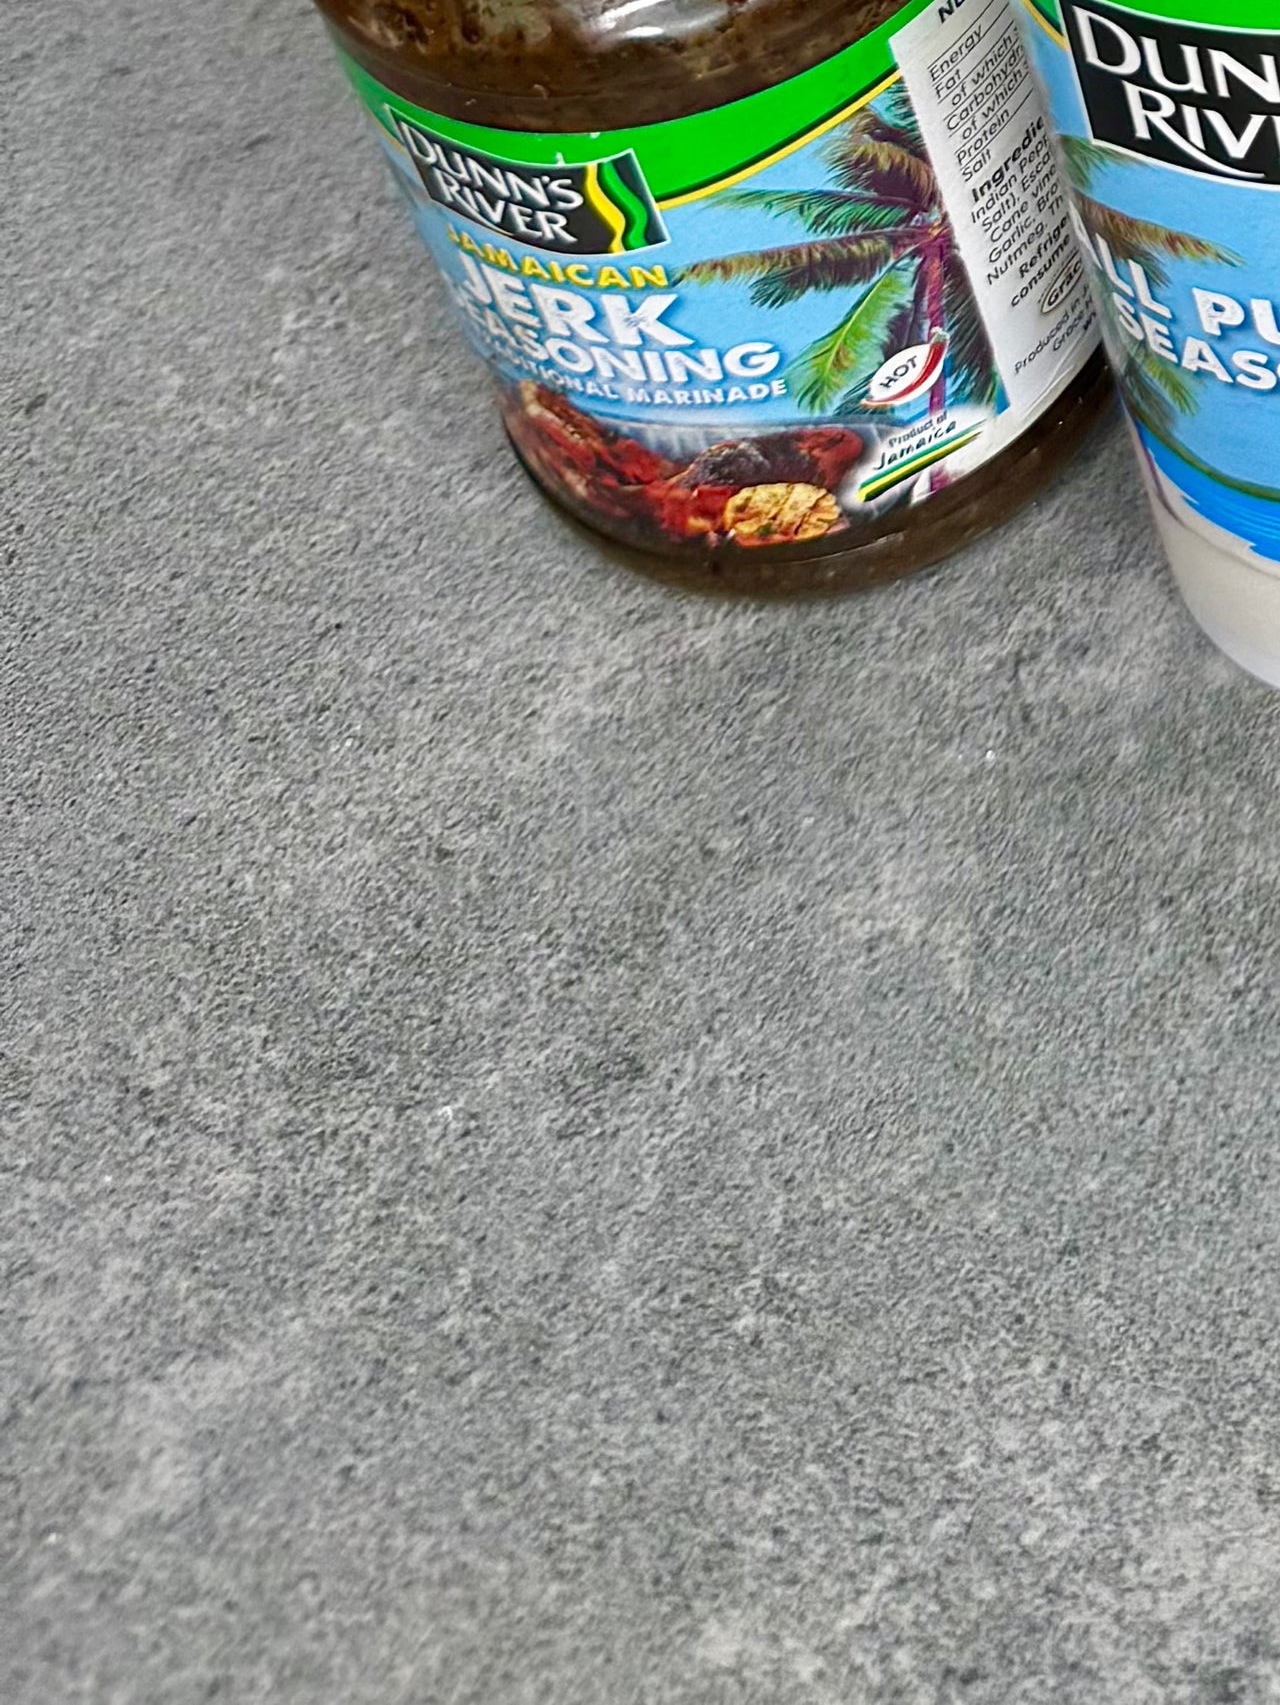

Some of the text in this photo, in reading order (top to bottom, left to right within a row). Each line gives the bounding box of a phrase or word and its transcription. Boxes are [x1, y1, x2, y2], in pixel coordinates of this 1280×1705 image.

[929, 25, 983, 82] Energy
[951, 34, 1012, 107] of which
[935, 68, 963, 98] Fat
[962, 69, 1023, 140] of which
[957, 108, 1010, 166] Protein
[400, 120, 583, 210] DUNN'S
[962, 147, 991, 182] Salt
[433, 166, 578, 244] RIVER
[971, 174, 1018, 223] Indian
[459, 250, 696, 347] JERK
[628, 378, 788, 406] MARINADE
[879, 355, 919, 388] HOT
[873, 419, 957, 471] Jamaica
[887, 410, 949, 448] Product of
